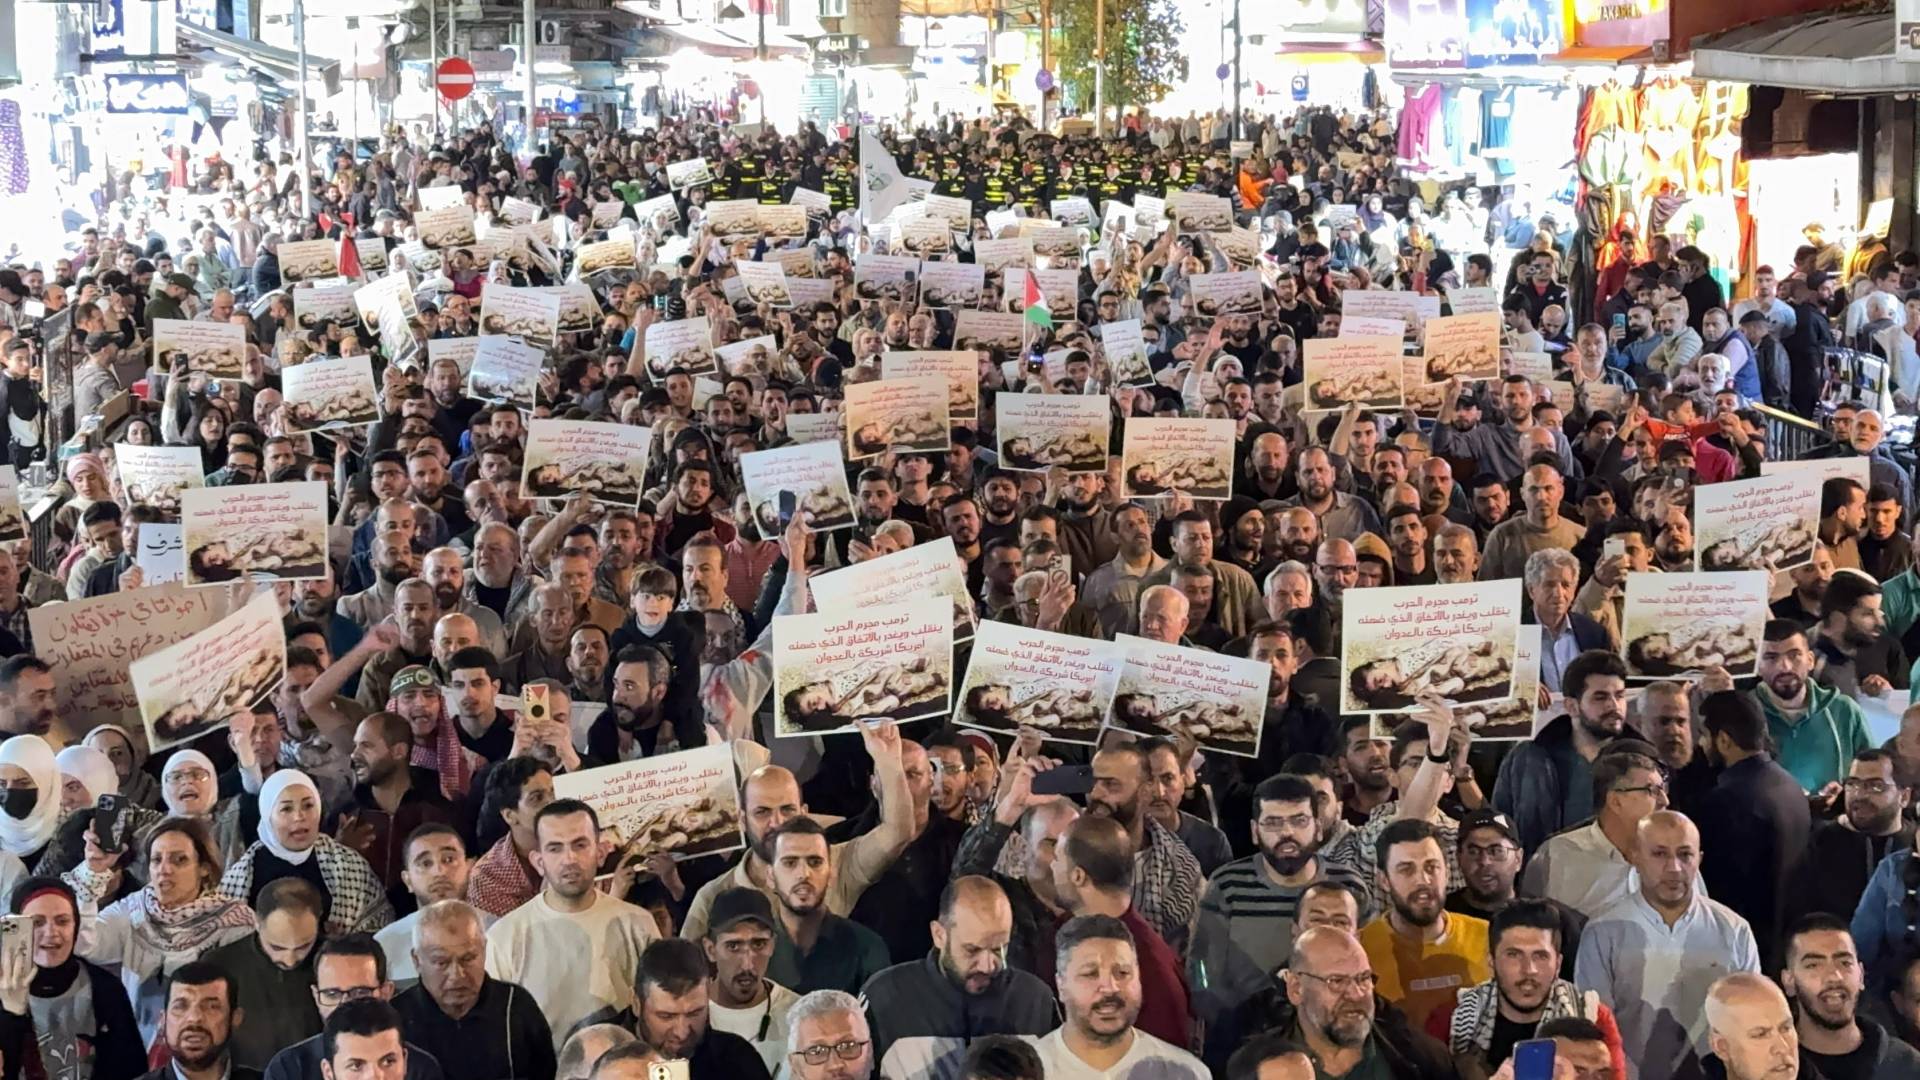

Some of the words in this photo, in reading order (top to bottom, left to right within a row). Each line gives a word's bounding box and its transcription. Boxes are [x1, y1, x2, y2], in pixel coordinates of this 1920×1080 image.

[1393, 596, 1423, 609] الحرب
[1424, 599, 1449, 608] مجرم
[1450, 593, 1478, 607] ترمب
[823, 619, 853, 633] الحرب
[855, 620, 879, 631] مجرم
[881, 612, 909, 627] ترمب
[884, 630, 909, 641] ويغدر
[910, 623, 942, 636] ينقلب
[818, 635, 843, 648] الذي
[846, 631, 881, 646] بالاتفاق
[815, 649, 856, 664] بالعدوان
[858, 644, 892, 658] شريكة
[634, 769, 658, 780] مجرم
[659, 760, 688, 775] ترمب
[603, 770, 632, 784] الحرب
